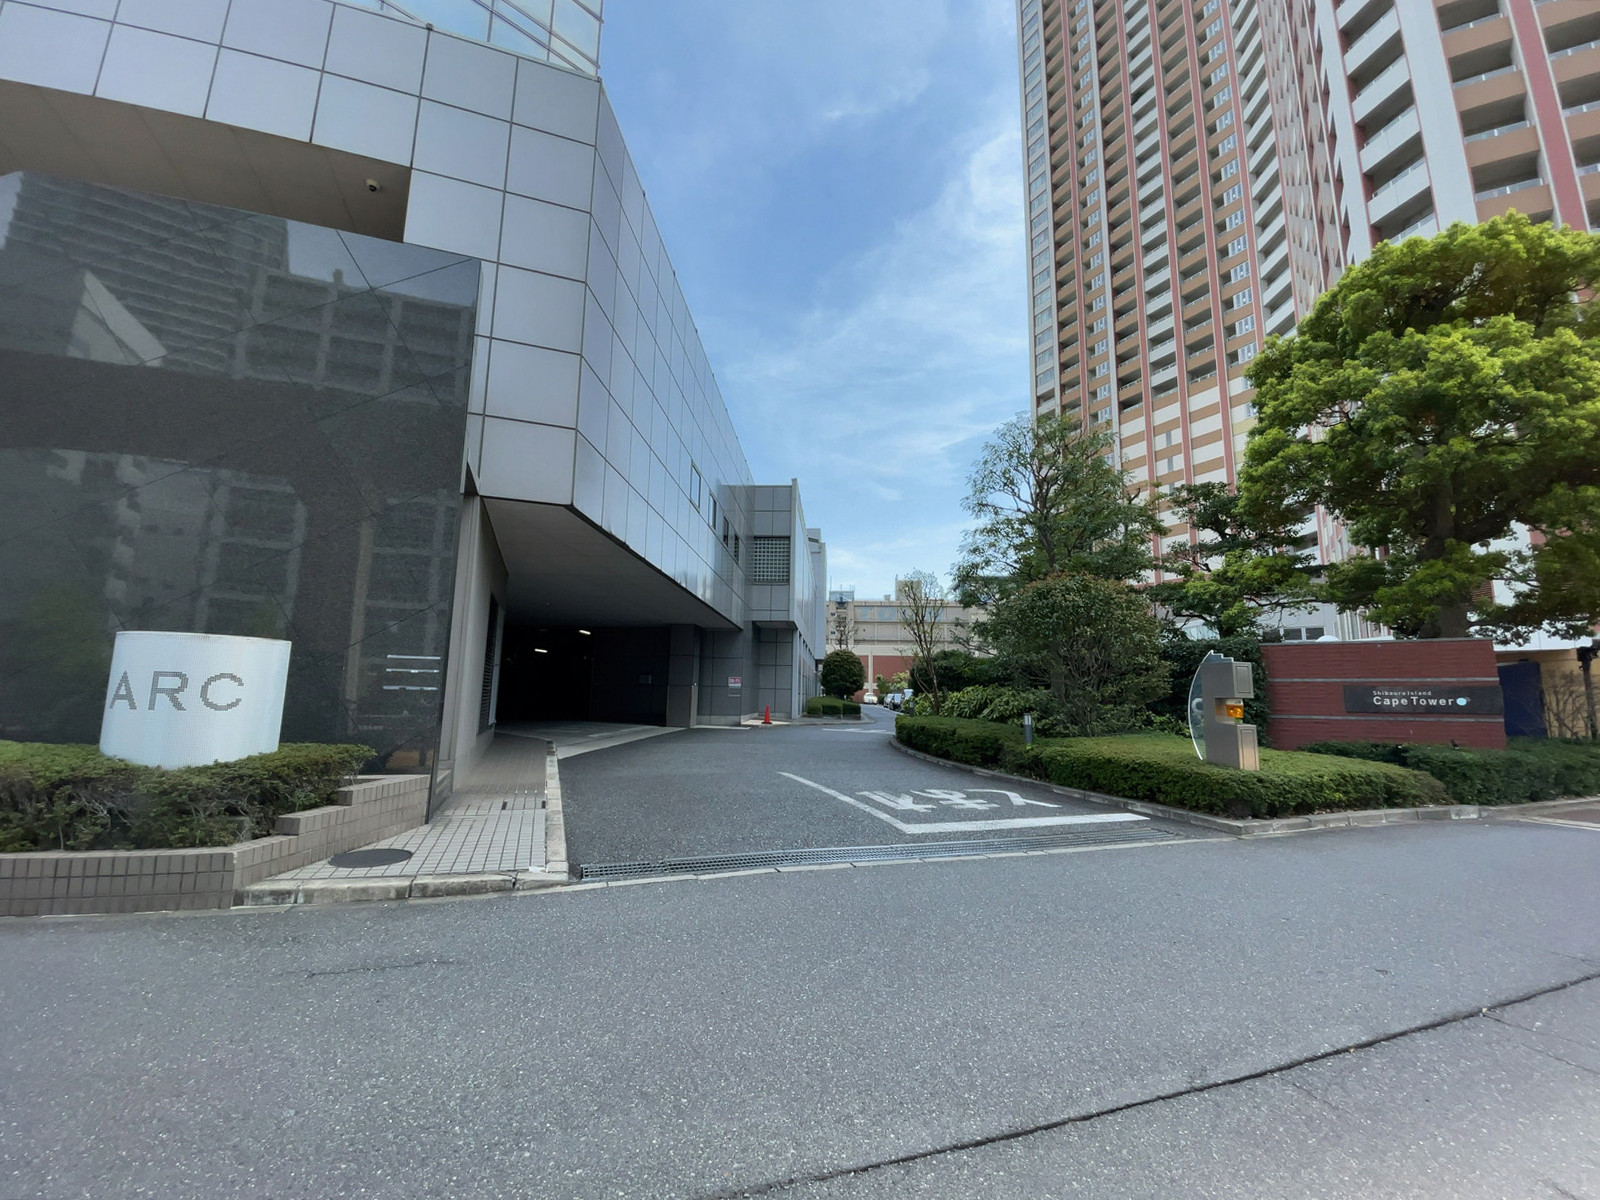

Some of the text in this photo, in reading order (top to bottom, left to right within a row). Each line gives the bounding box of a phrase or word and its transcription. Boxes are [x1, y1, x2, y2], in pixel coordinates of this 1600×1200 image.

[109, 670, 245, 711] ARC
[1373, 696, 1454, 706] Cape Tower
[855, 789, 1062, 813] とまれ
